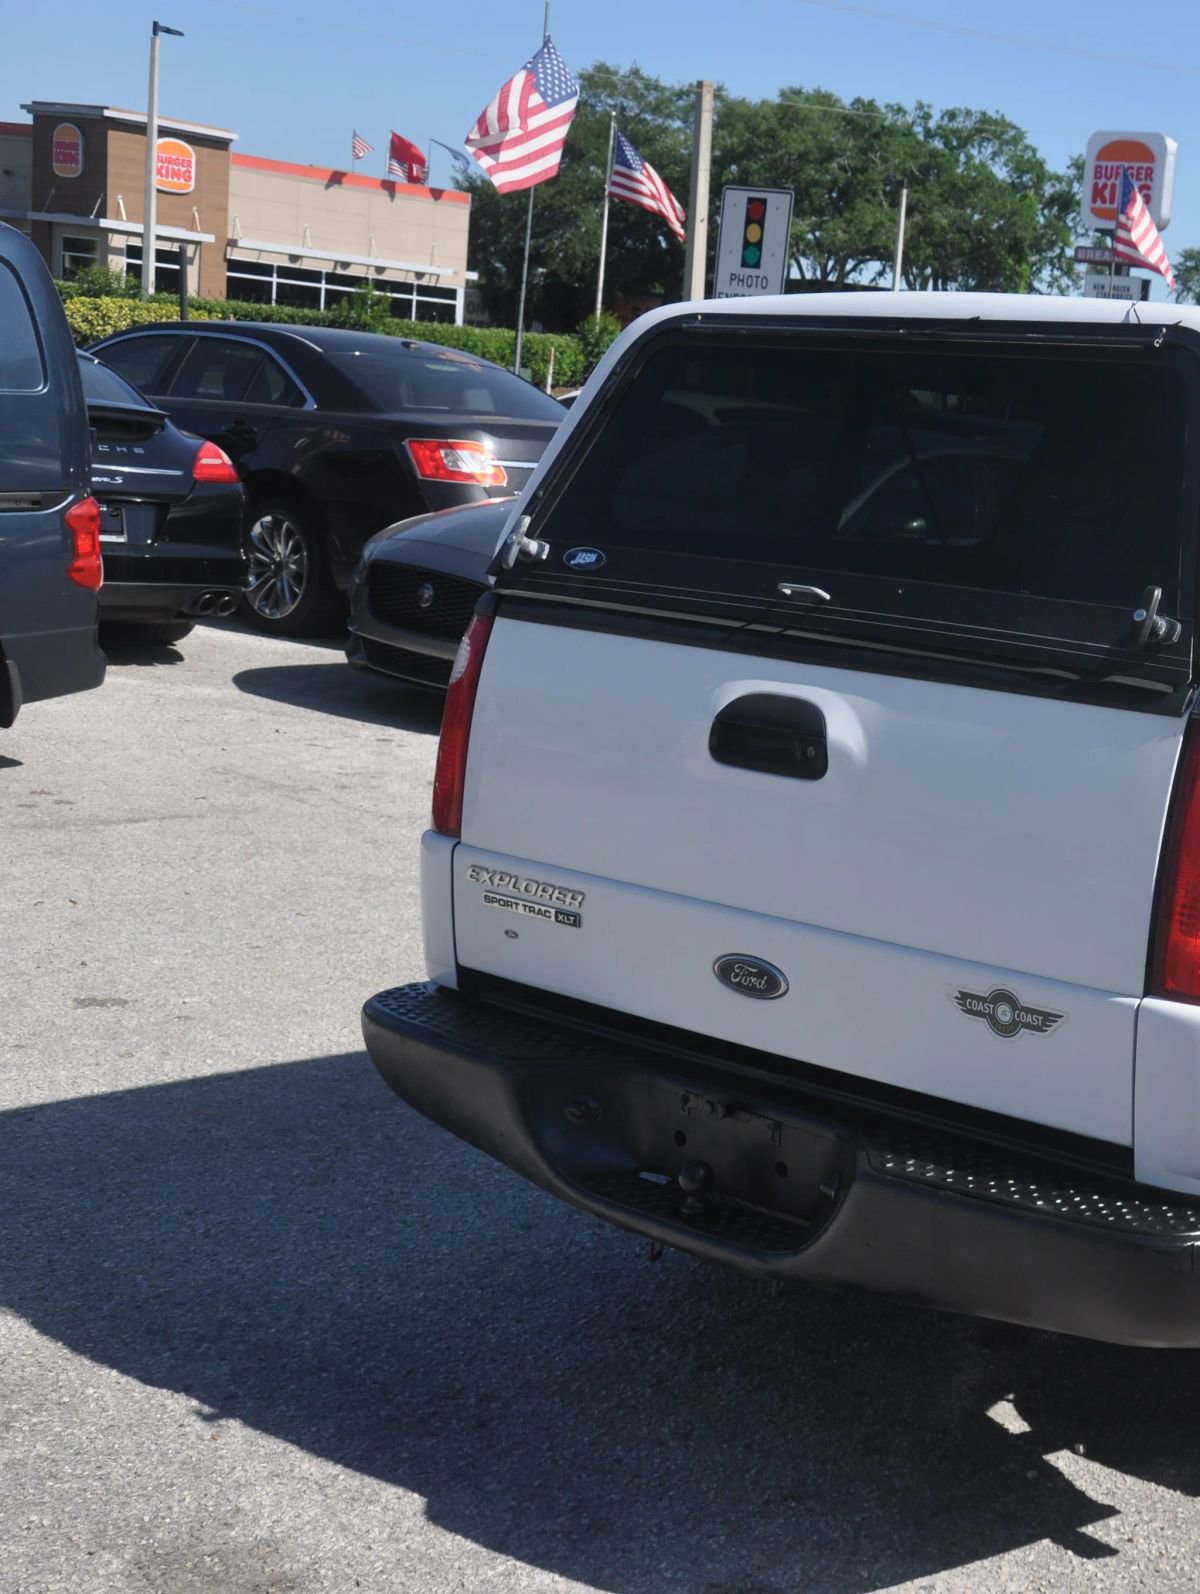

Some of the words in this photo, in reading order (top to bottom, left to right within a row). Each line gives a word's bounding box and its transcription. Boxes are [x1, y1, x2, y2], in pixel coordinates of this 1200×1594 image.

[156, 165, 193, 182] KING
[1091, 181, 1153, 206] KIG
[729, 272, 769, 290] PHOTO
[466, 864, 586, 909] EXPLORER
[483, 893, 520, 911] SPORT
[521, 903, 552, 919] TRAC
[556, 911, 575, 925] XLT
[730, 963, 768, 989] Ford
[966, 998, 995, 1015] COAST
[1014, 1010, 1044, 1027] COAST
